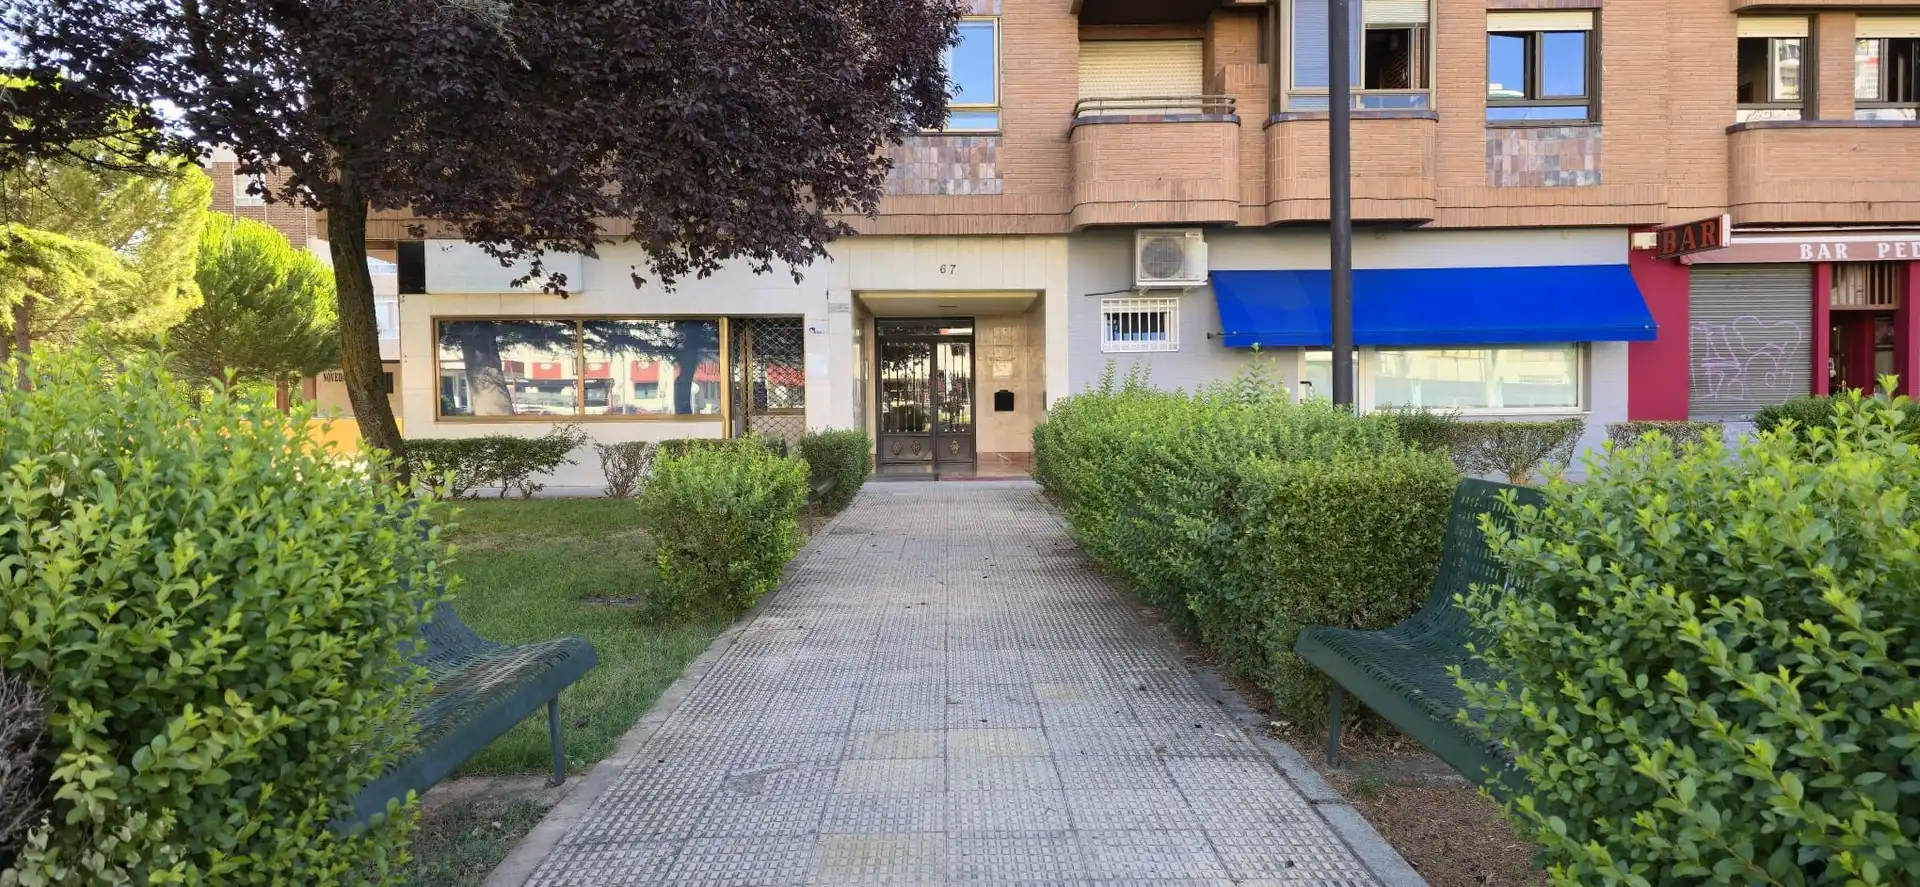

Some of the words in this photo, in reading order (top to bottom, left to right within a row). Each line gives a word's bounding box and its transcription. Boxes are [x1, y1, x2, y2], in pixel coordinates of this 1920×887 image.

[1661, 221, 1717, 254] BAR
[1800, 243, 1848, 260] BAR
[940, 264, 956, 274] 67
